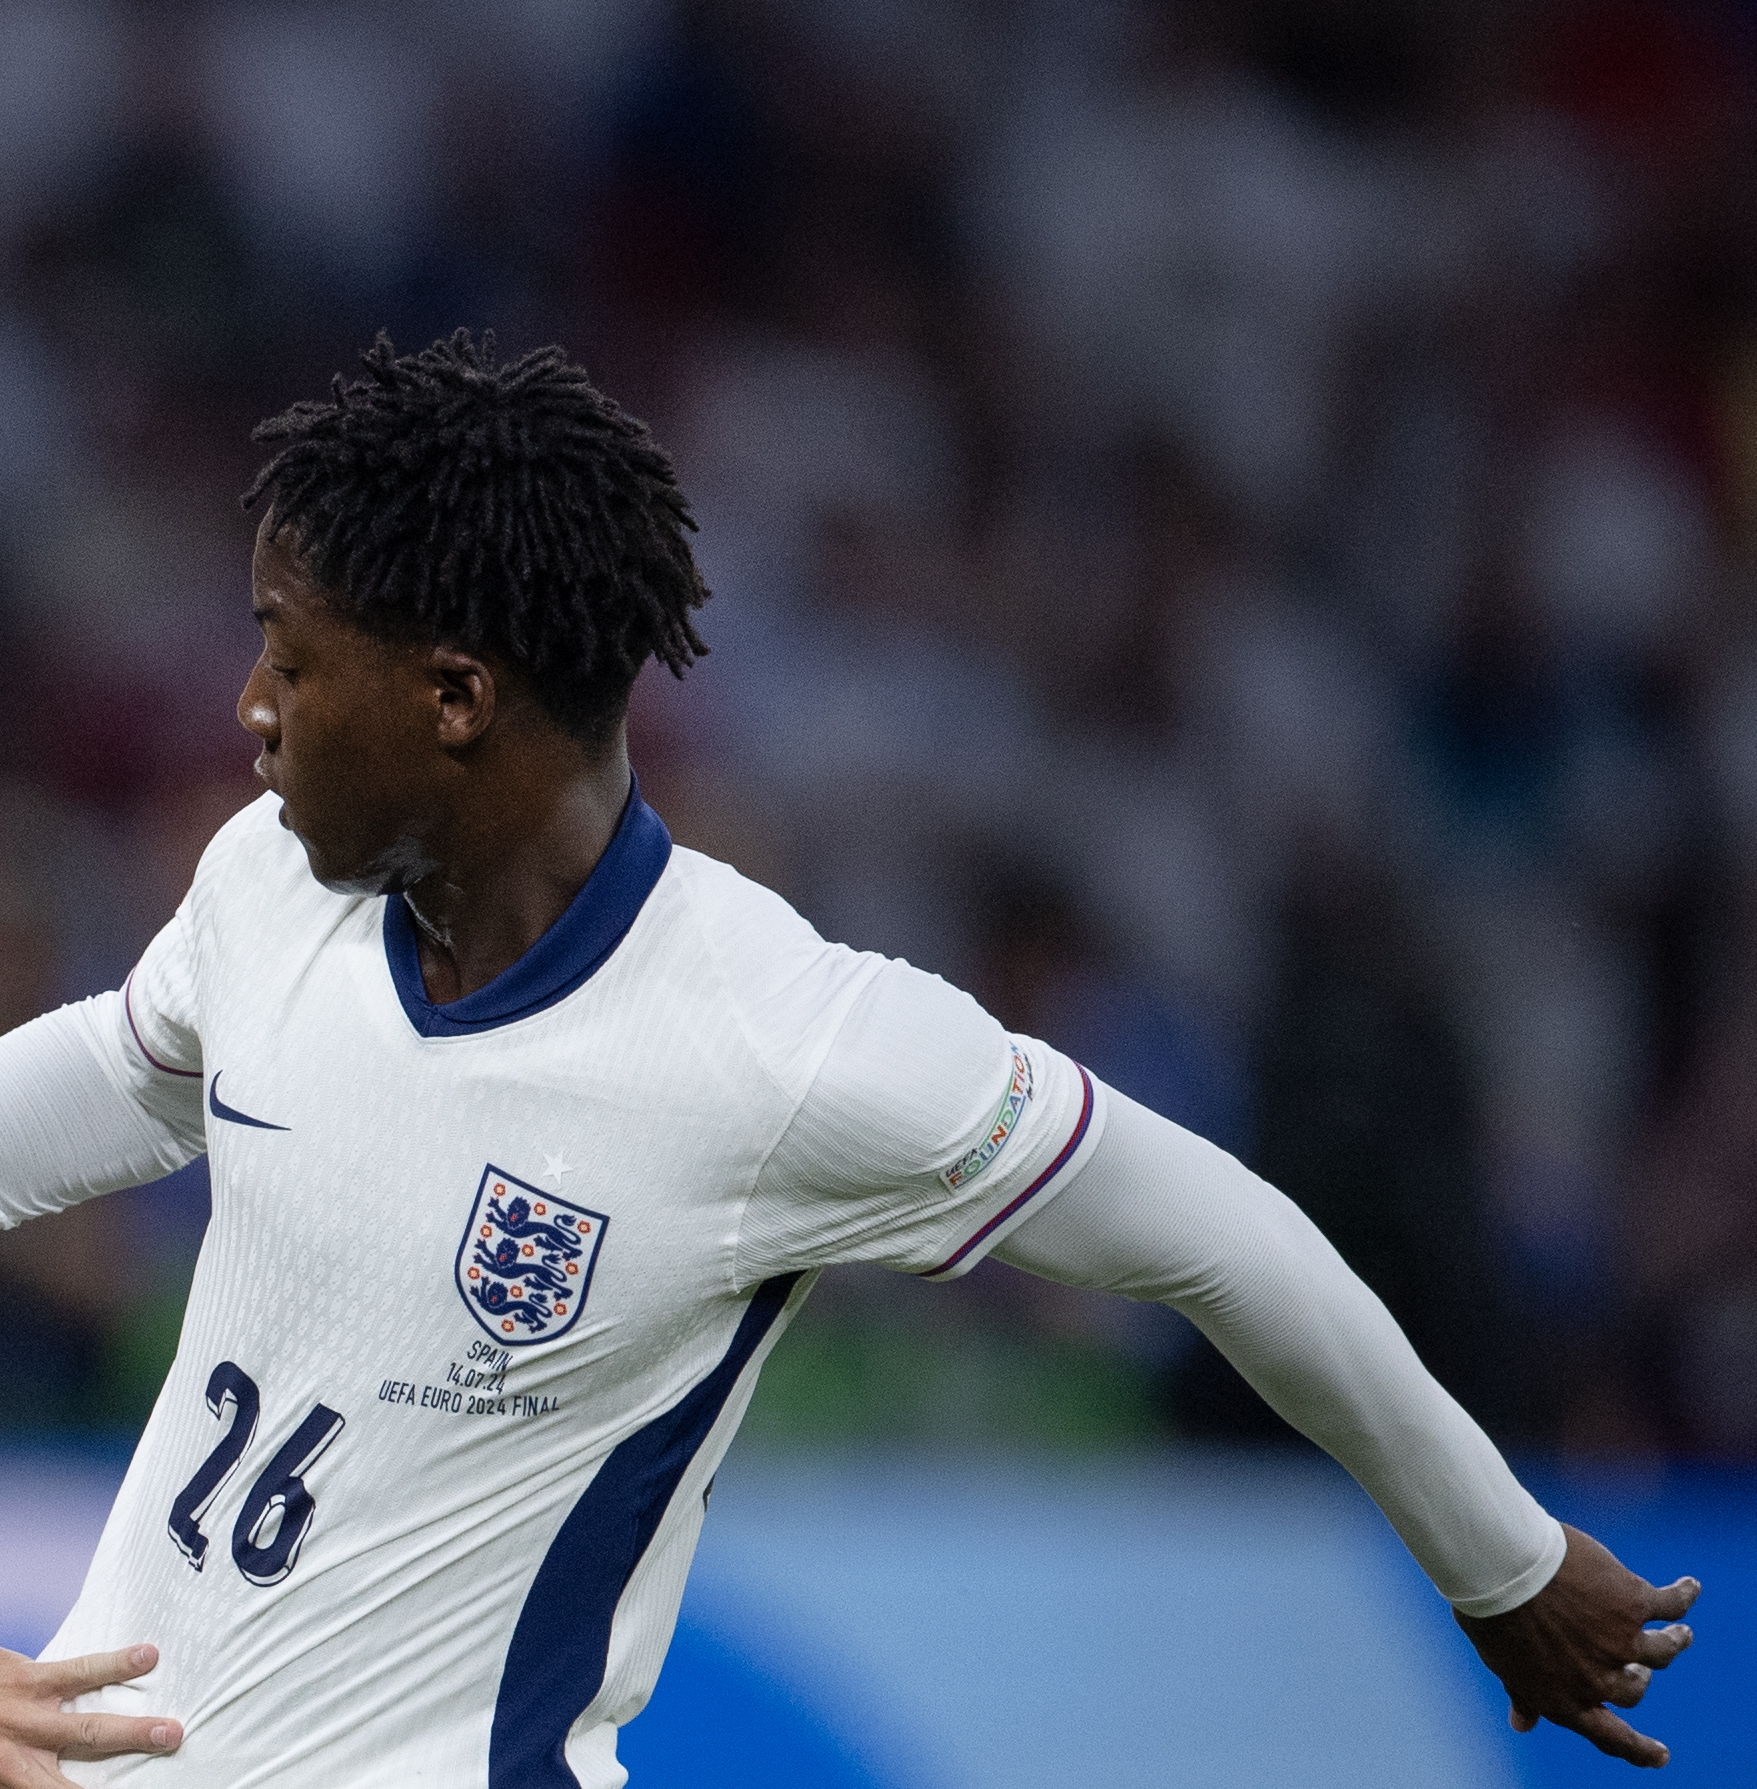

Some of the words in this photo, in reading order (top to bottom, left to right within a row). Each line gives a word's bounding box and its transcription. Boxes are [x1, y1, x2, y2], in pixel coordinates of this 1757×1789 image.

[466, 1340, 514, 1372] SPAIN
[445, 1361, 507, 1395] 14.07.24
[378, 1379, 416, 1406] UEFA
[420, 1385, 463, 1414] EURO
[466, 1394, 507, 1416] 2024
[511, 1395, 560, 1417] FINAL
[167, 1359, 347, 1588] 26
